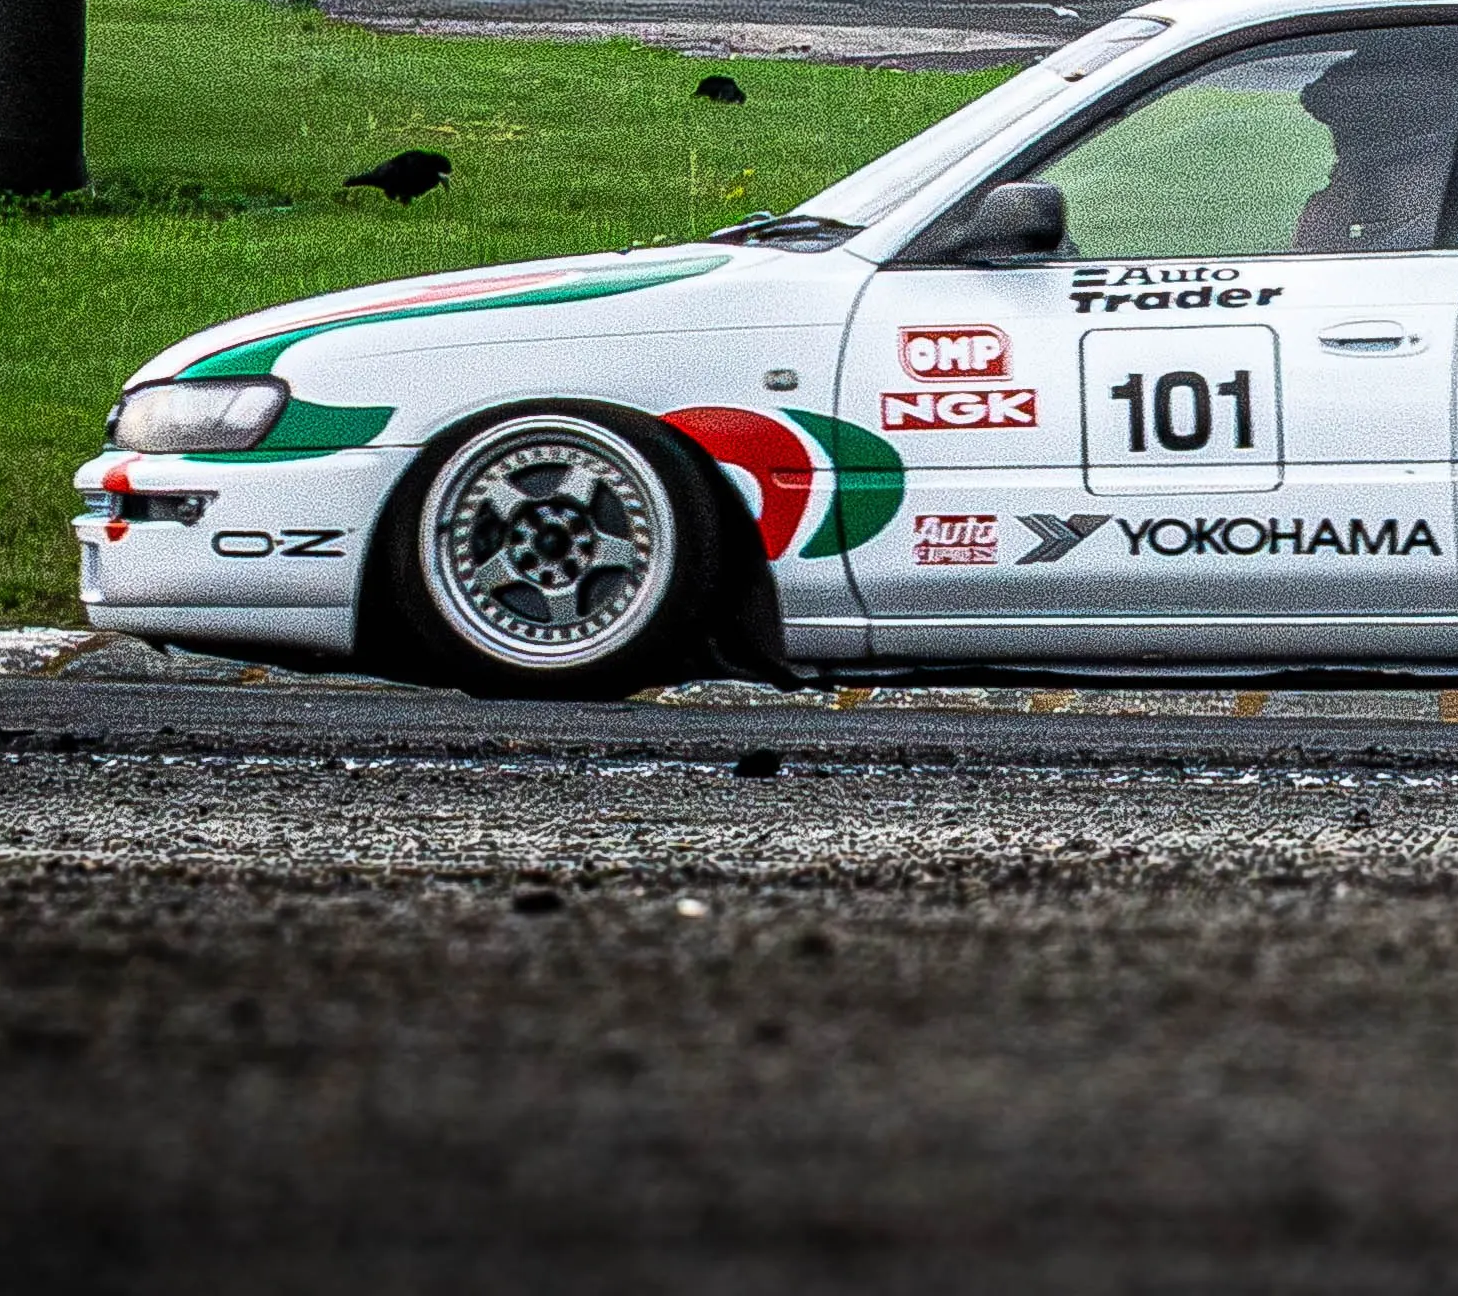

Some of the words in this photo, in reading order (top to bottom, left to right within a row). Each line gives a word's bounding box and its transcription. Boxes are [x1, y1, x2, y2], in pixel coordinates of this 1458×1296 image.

[1106, 266, 1240, 287] Auto
[1068, 285, 1286, 314] Trader
[905, 333, 1001, 375] OMP
[883, 392, 1037, 426] NGK
[1108, 369, 1255, 452] 101
[1116, 518, 1443, 557] YOKOHAMA
